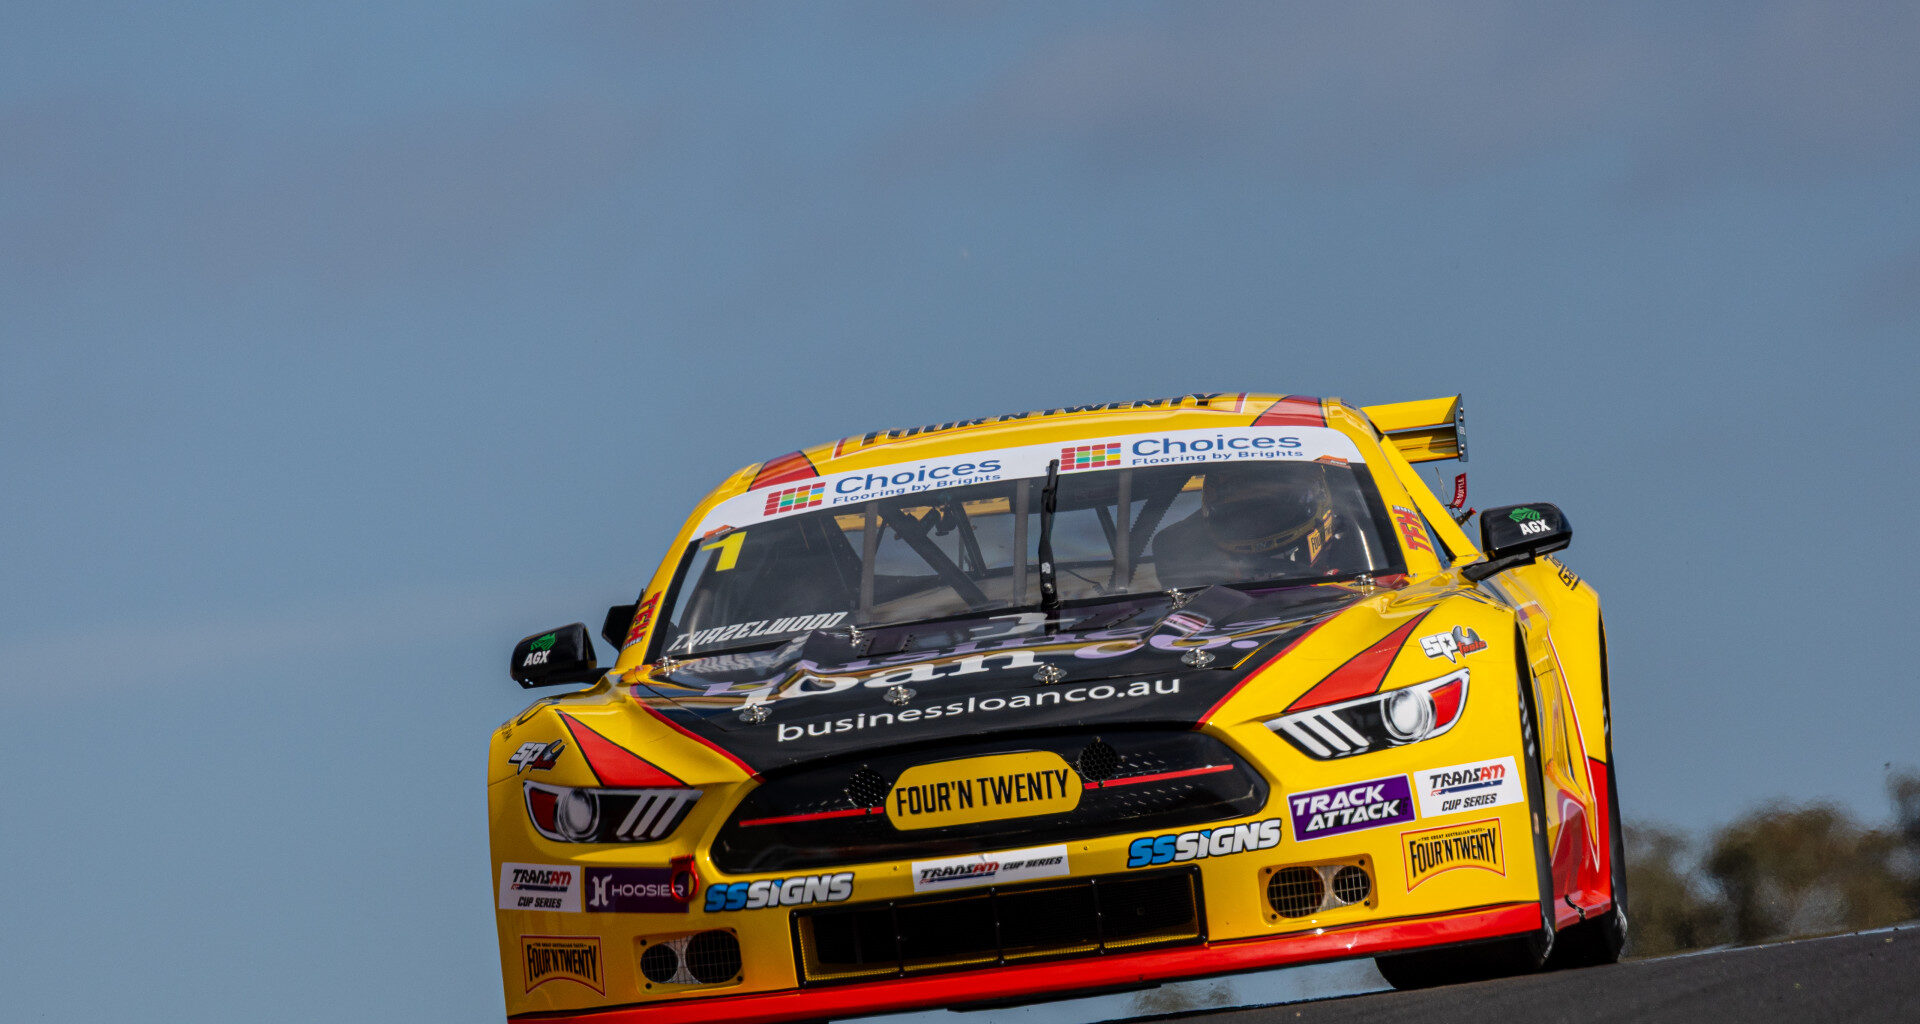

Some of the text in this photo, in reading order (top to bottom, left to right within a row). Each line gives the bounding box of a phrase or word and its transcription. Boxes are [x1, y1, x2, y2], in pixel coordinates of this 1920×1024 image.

[1132, 434, 1302, 457] Choices
[1132, 449, 1304, 466] Flooring by Brights
[832, 473, 1002, 505] Flooring by Brights
[835, 458, 1002, 495] Choices
[1519, 518, 1552, 536] AGX
[701, 531, 747, 572] 1
[523, 650, 551, 667] AGX
[777, 678, 1181, 743] businessloanco.au
[1430, 763, 1505, 789] TRANSAM
[896, 768, 1069, 817] FOUR'N TWENTY
[1293, 783, 1386, 817] TRACK
[1442, 793, 1498, 812] CUP SERIES
[1305, 799, 1401, 833] ATTACK
[1409, 827, 1497, 878] FOUR'N TWENTY
[512, 868, 572, 885] TRANSAM
[921, 856, 1064, 879] TRANSAM CUP SERIES
[517, 896, 563, 909] CUP SERIES
[611, 884, 684, 898] HOOSIER
[558, 945, 598, 982] TWENTY
